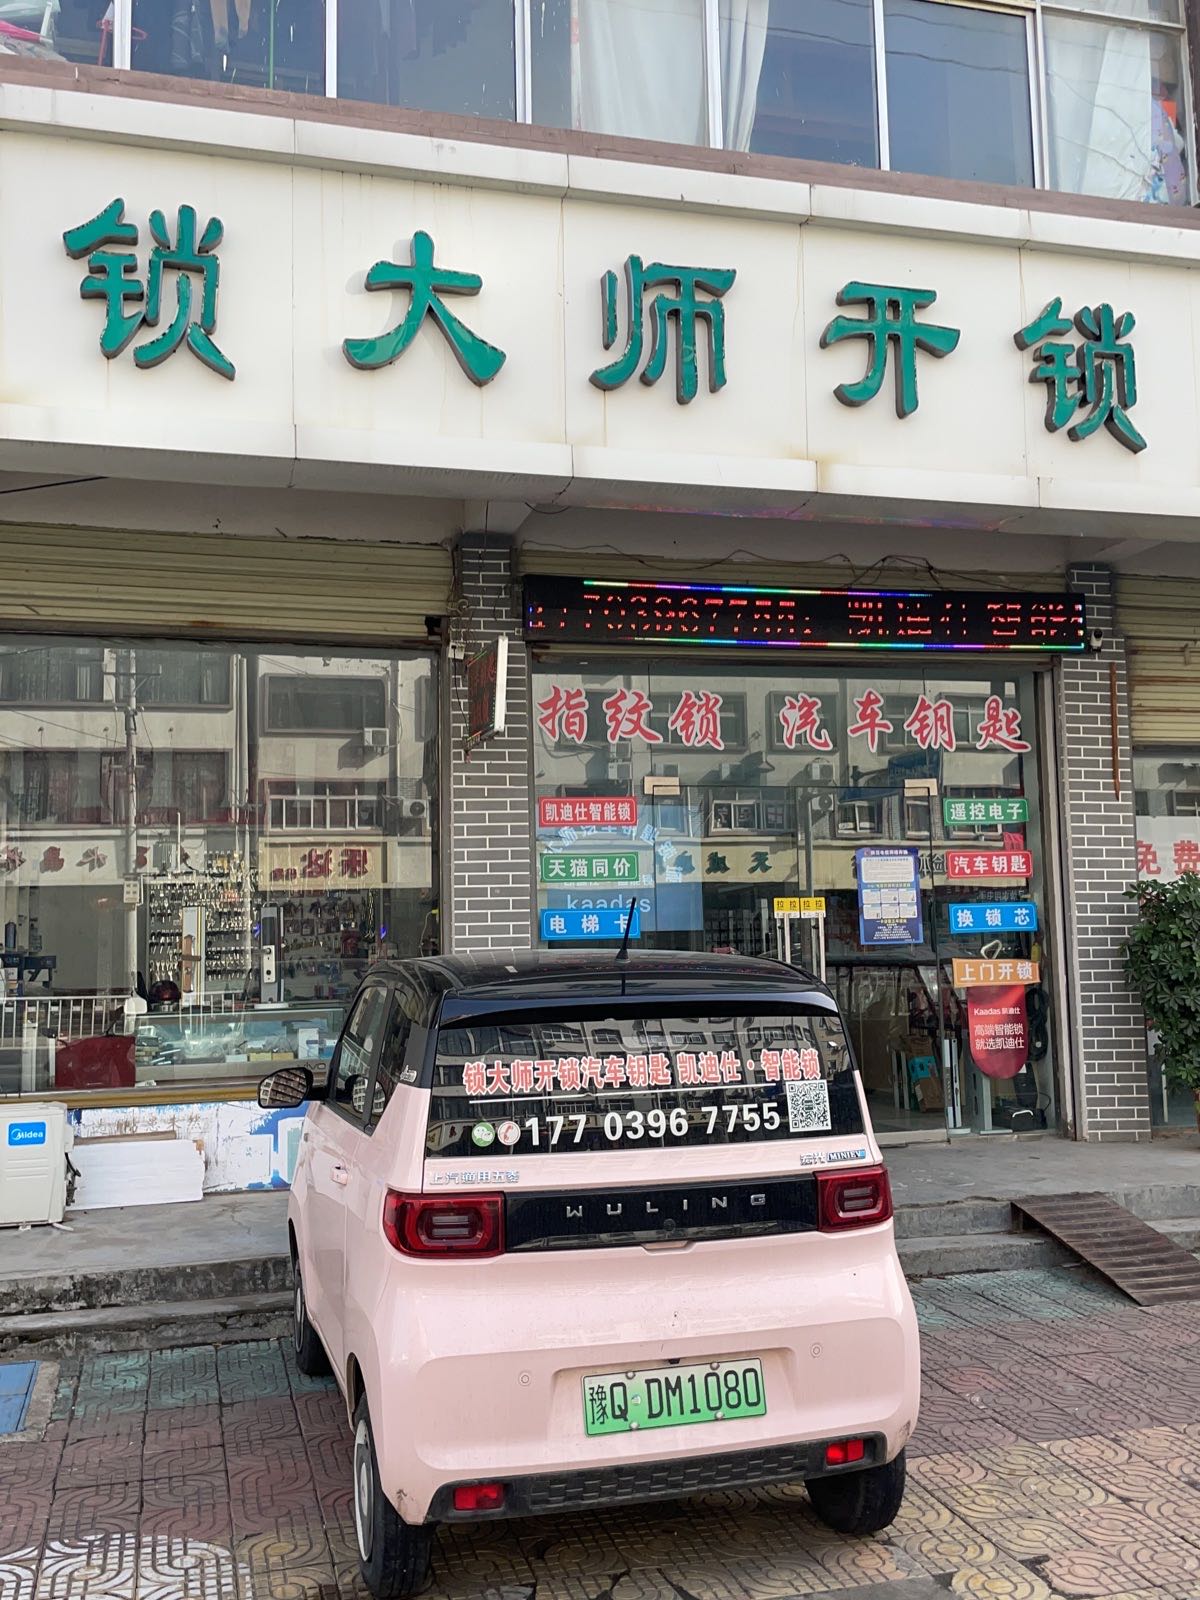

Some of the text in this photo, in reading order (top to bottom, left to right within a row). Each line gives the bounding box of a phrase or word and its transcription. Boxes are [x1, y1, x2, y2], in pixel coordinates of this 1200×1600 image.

[62, 197, 1147, 455] 锁大师开锁
[536, 684, 726, 752] 指纹锁
[779, 689, 1034, 754] 汽车钥匙
[545, 802, 631, 822] 凯迪仕智能锁
[950, 803, 1023, 820] 遥控电子
[548, 858, 631, 878] 天猫同价
[954, 853, 1027, 874] 汽车钥匙
[549, 913, 631, 934] 电梯卡
[957, 908, 1030, 927] 换锁芯
[960, 961, 1033, 981] 上门开锁
[974, 1023, 1024, 1036] 高端智能锁
[975, 1037, 1025, 1050] 就选凯迪仕
[462, 1053, 671, 1095] 锁大师开锁汽车钥匙
[525, 1102, 780, 1146] 177 0396 7755
[15, 1130, 44, 1140] Midea
[429, 1169, 520, 1186] 上汽通用五菱
[565, 1194, 767, 1219] WULING
[645, 1368, 761, 1420] DM1080
